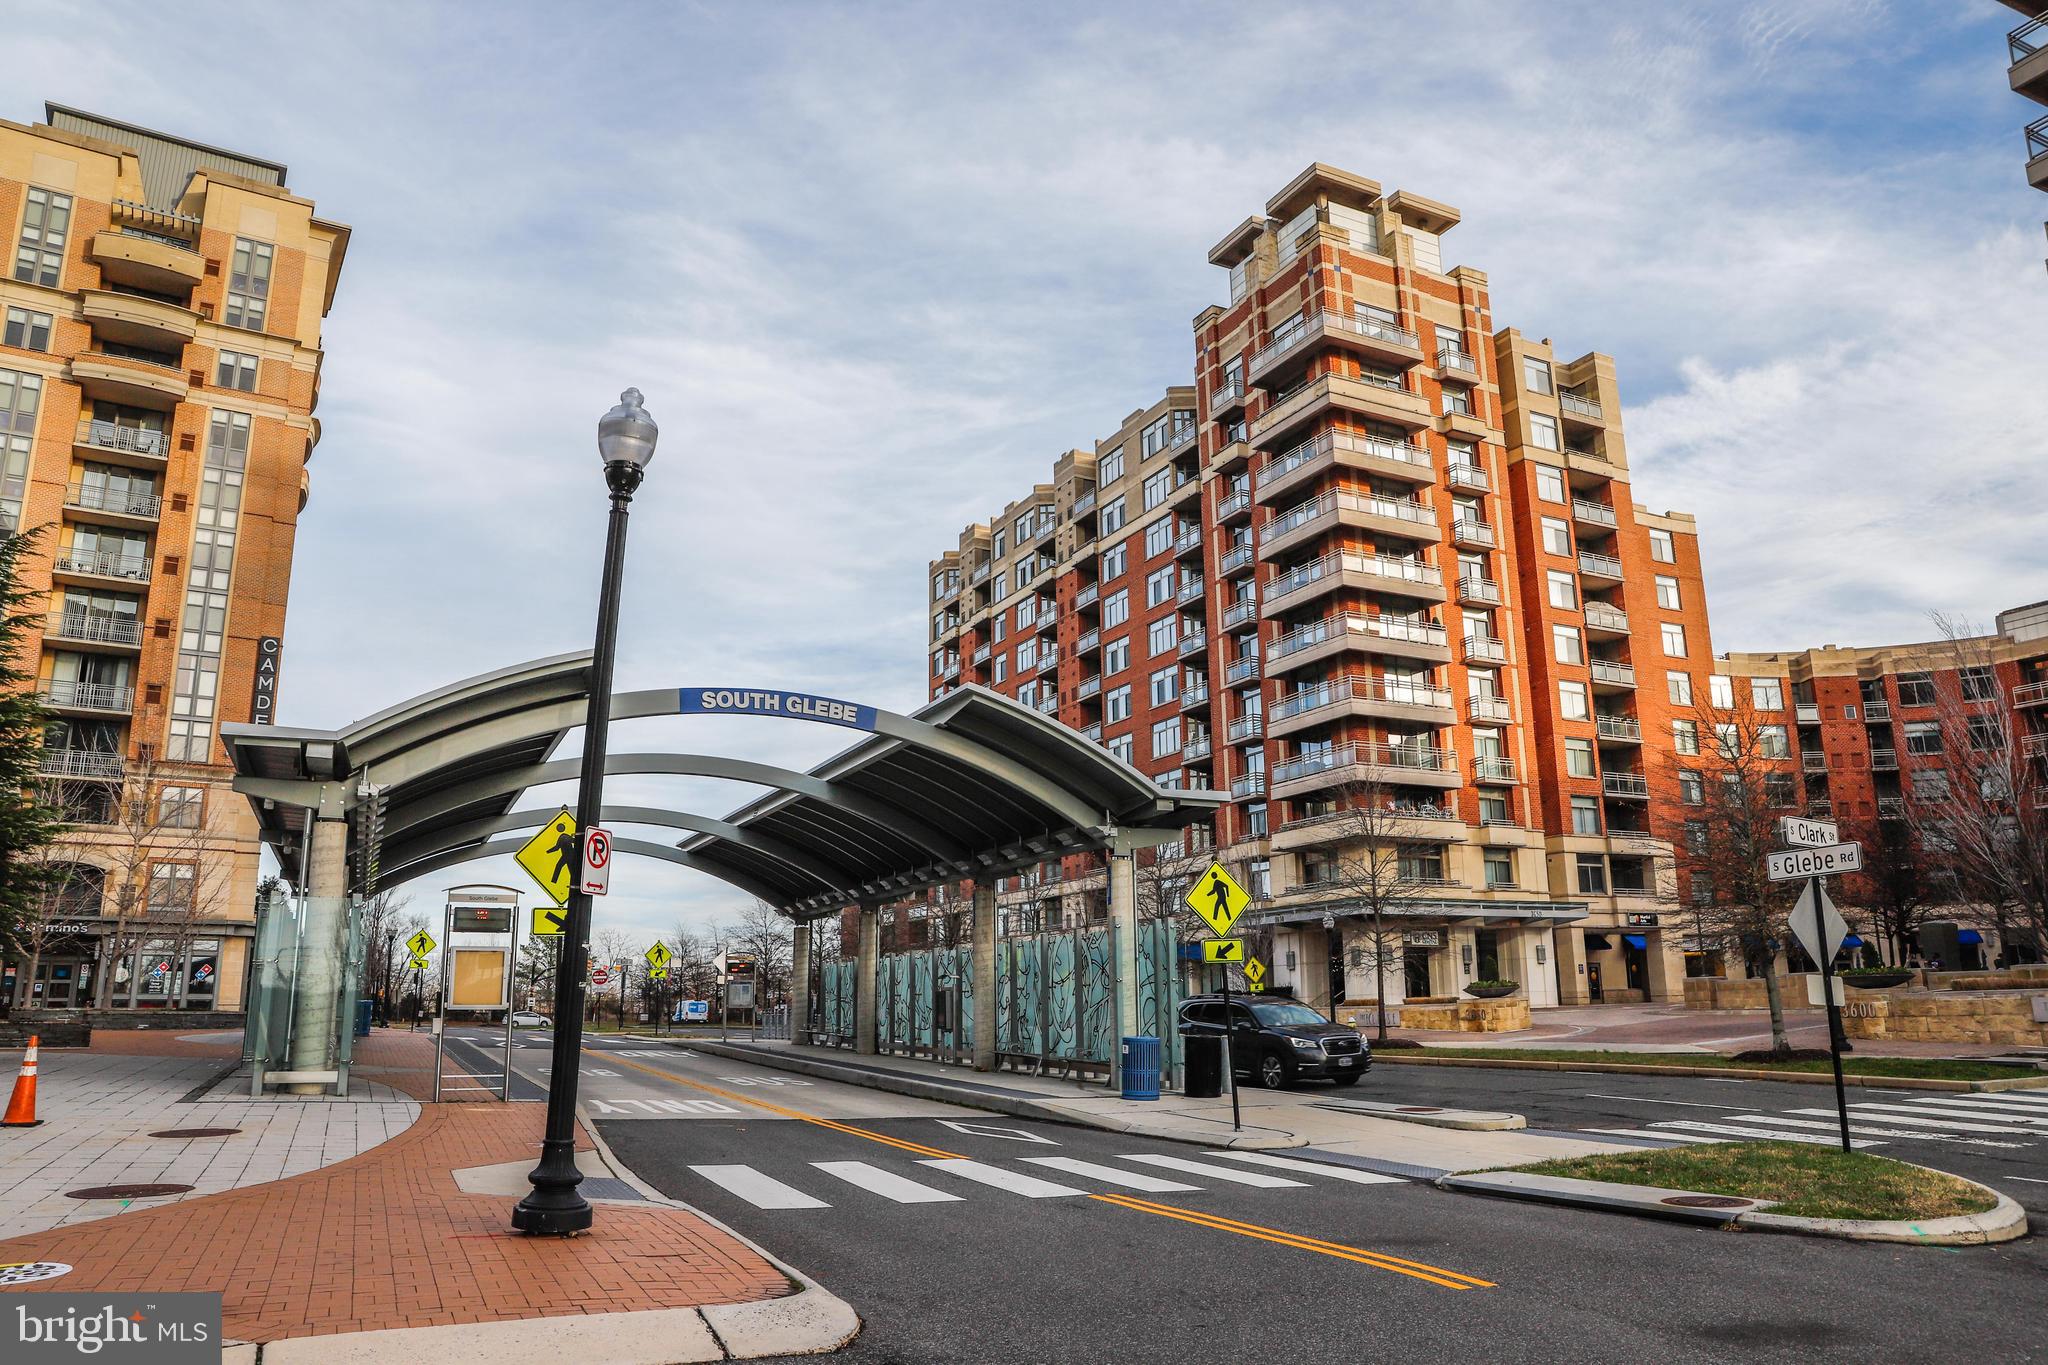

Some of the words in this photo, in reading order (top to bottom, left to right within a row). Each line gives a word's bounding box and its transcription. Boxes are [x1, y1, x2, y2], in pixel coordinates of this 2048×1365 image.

[701, 691, 780, 711] SOUTH
[785, 696, 858, 723] GLEBE
[1790, 825, 1795, 835] S
[1798, 823, 1827, 844] Clark
[1829, 831, 1835, 841] St
[593, 838, 605, 861] P
[1773, 862, 1780, 871] S
[1783, 852, 1834, 874] Glebe
[1840, 851, 1854, 863] Rd
[26, 922, 88, 933] mino's
[1842, 1001, 1876, 1018] 3600
[614, 1050, 699, 1058] ONLY
[717, 1076, 814, 1086] BUS
[589, 1099, 741, 1114] ONLY
